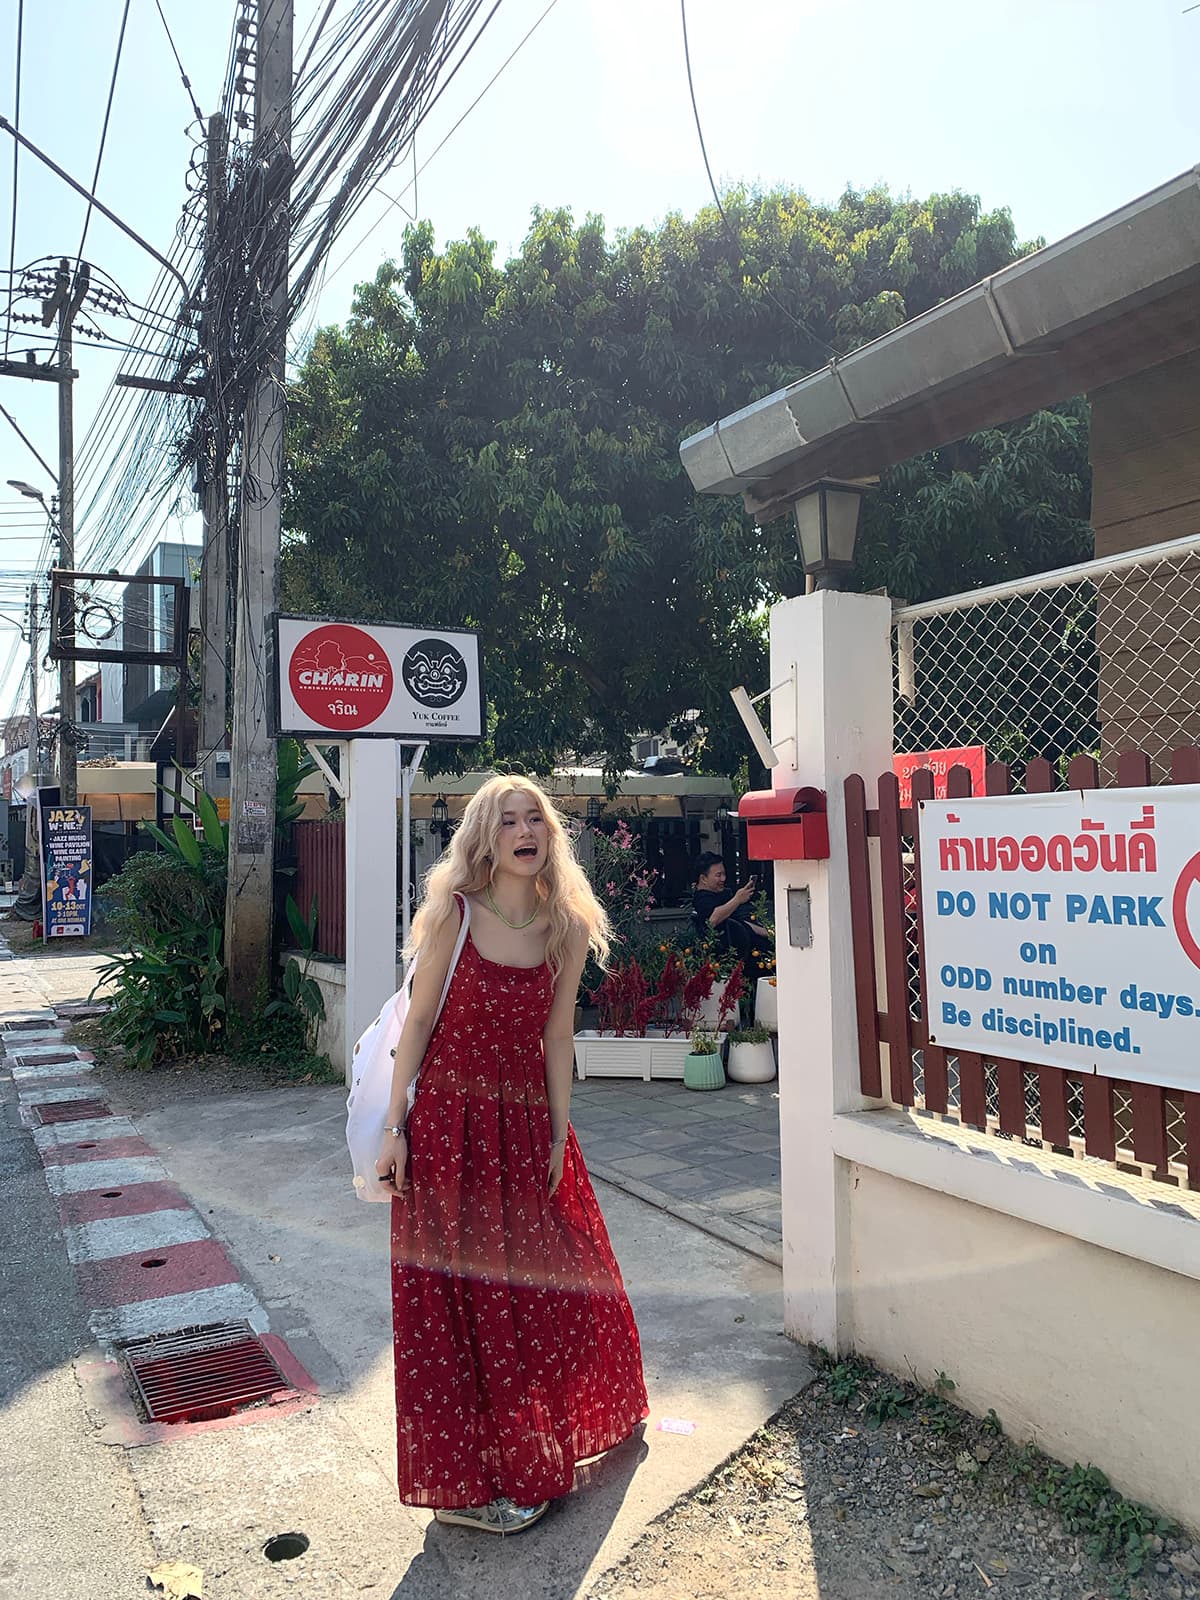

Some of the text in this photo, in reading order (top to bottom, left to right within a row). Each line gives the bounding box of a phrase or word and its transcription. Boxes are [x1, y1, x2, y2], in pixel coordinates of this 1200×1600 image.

[298, 670, 384, 688] CHARIN
[327, 699, 358, 716] จริณ
[938, 805, 1157, 872] ห้ามจอดวันคี่
[936, 889, 1167, 928] DO NOT PARK
[1019, 941, 1057, 965] on
[940, 963, 1200, 1020] ODD number days.
[942, 1001, 1142, 1054] Be disciplined.
